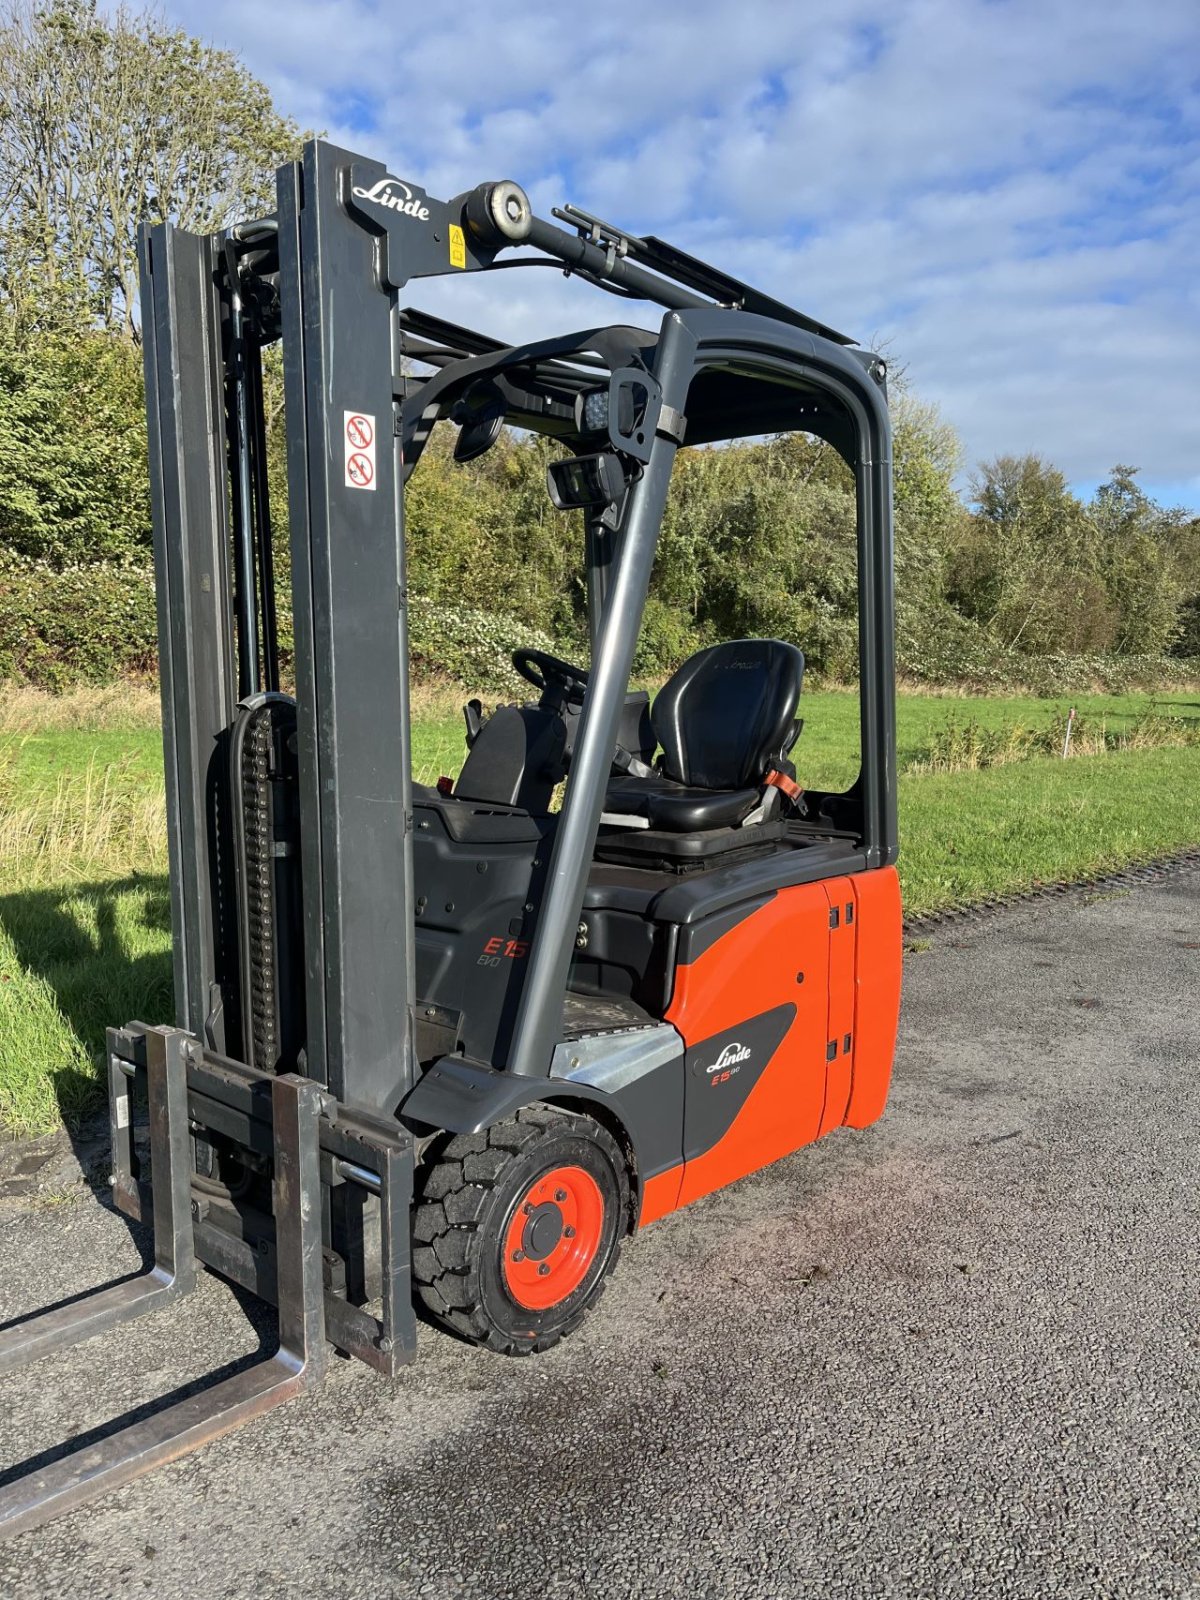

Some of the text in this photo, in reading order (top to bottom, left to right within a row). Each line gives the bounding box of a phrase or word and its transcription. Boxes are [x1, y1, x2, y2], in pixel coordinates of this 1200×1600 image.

[352, 179, 430, 221] Linde
[477, 955, 501, 967] EVO
[706, 1043, 751, 1073] Linde
